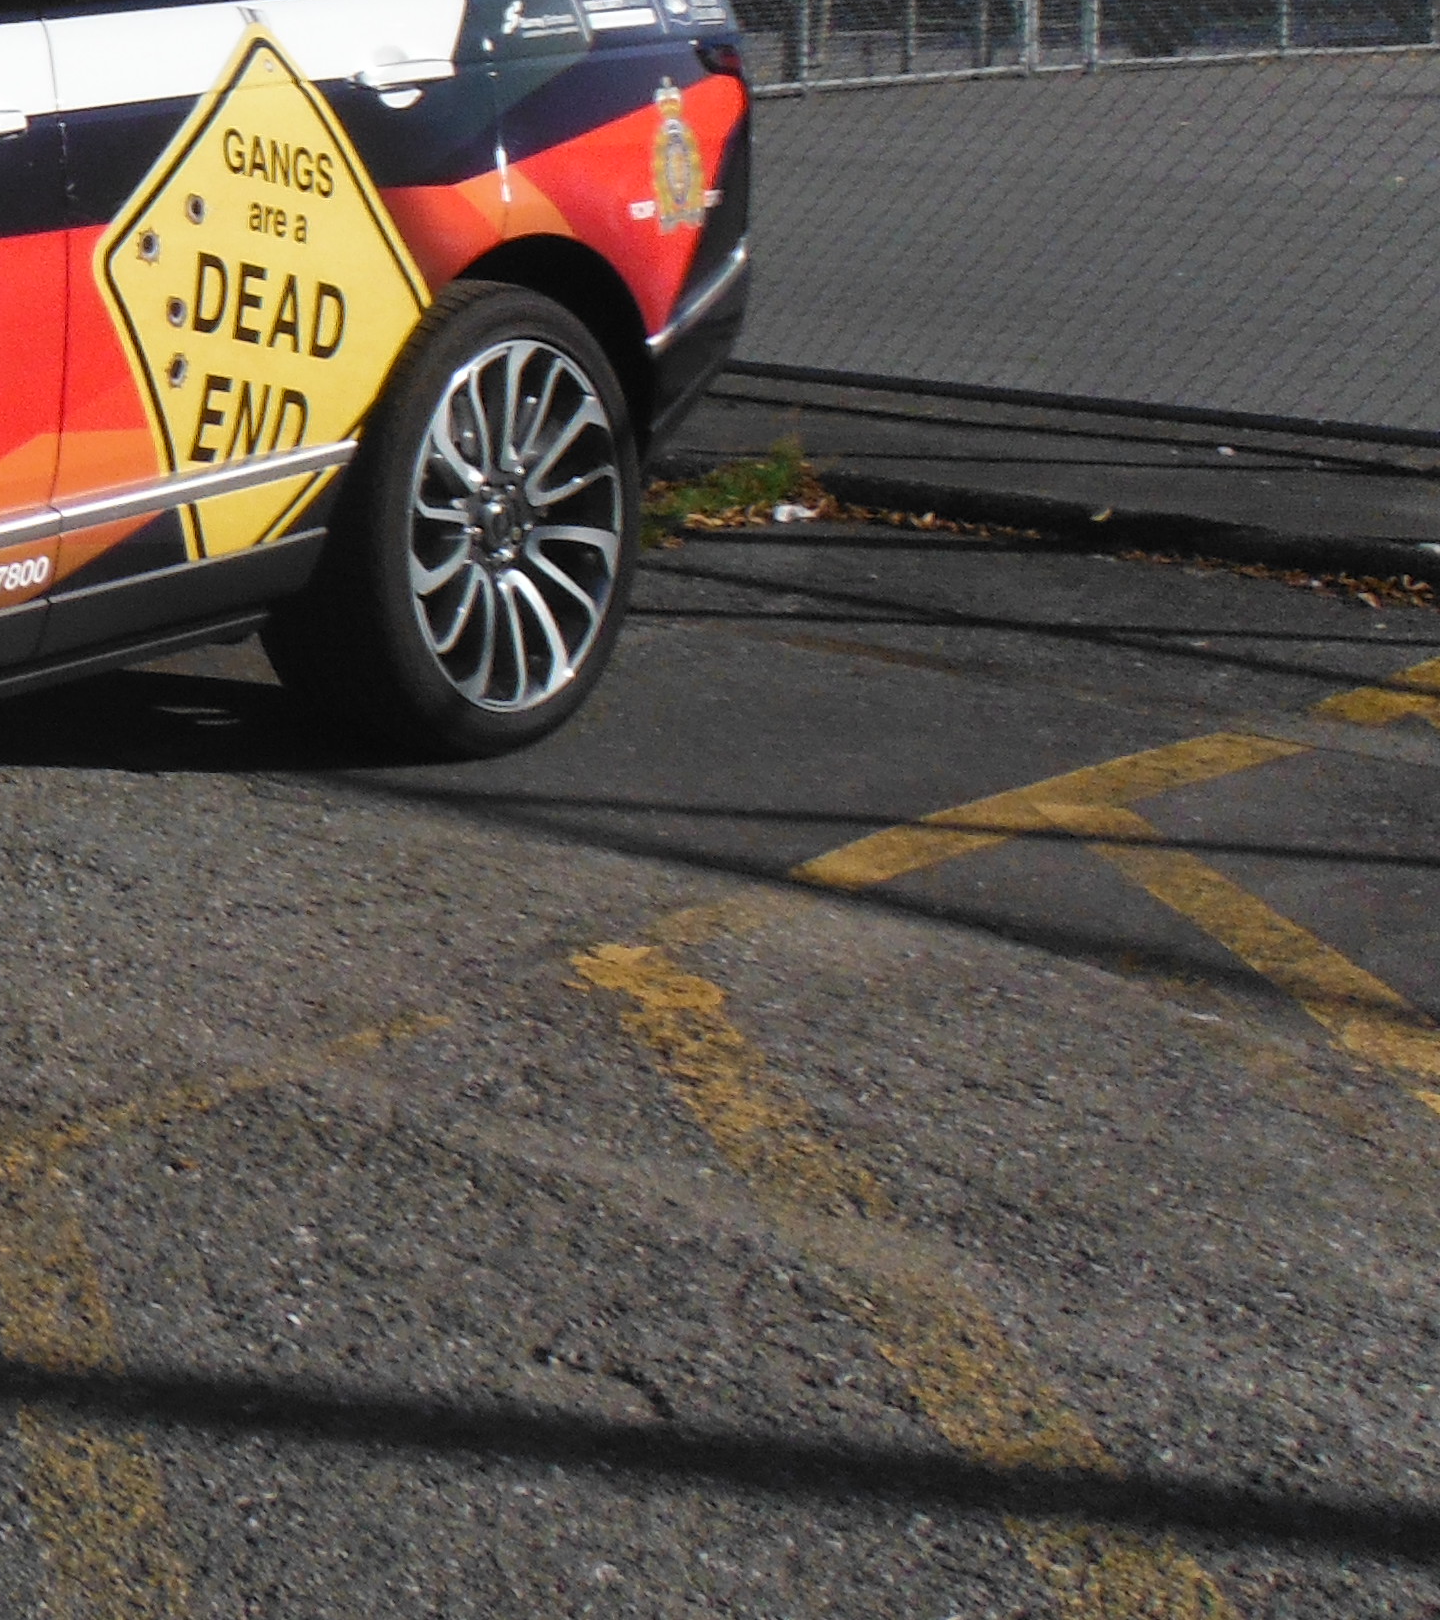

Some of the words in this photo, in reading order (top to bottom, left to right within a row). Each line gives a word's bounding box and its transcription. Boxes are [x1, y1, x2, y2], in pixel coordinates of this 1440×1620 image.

[222, 127, 335, 199] GANGS
[248, 200, 288, 237] are
[294, 218, 308, 242] a
[192, 252, 348, 360] DEAD
[190, 374, 308, 463] END
